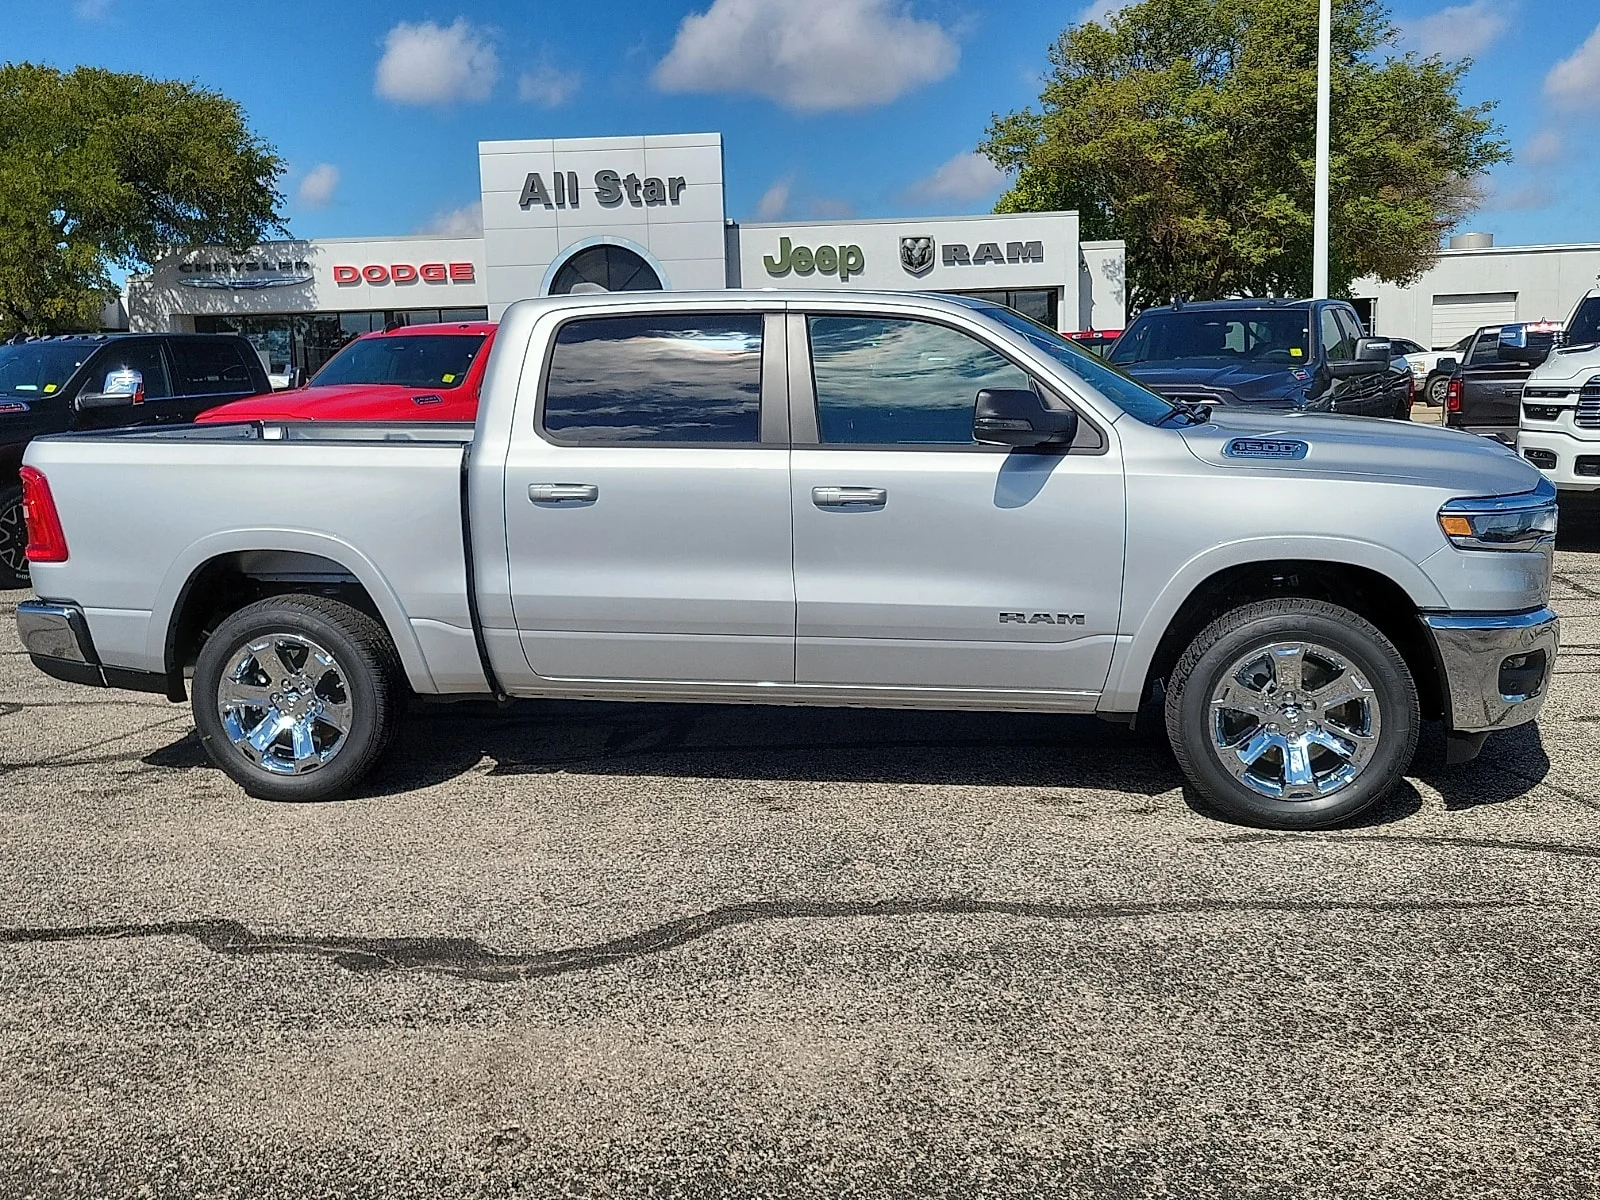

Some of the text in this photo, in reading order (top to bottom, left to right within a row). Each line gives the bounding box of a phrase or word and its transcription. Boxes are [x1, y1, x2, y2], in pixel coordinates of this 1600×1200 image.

[518, 169, 686, 208] All Star
[763, 236, 865, 281] Jeep
[941, 240, 1044, 265] RAM
[178, 261, 310, 273] CHRYSLER
[332, 262, 475, 286] DODGE
[999, 611, 1085, 625] RAM
